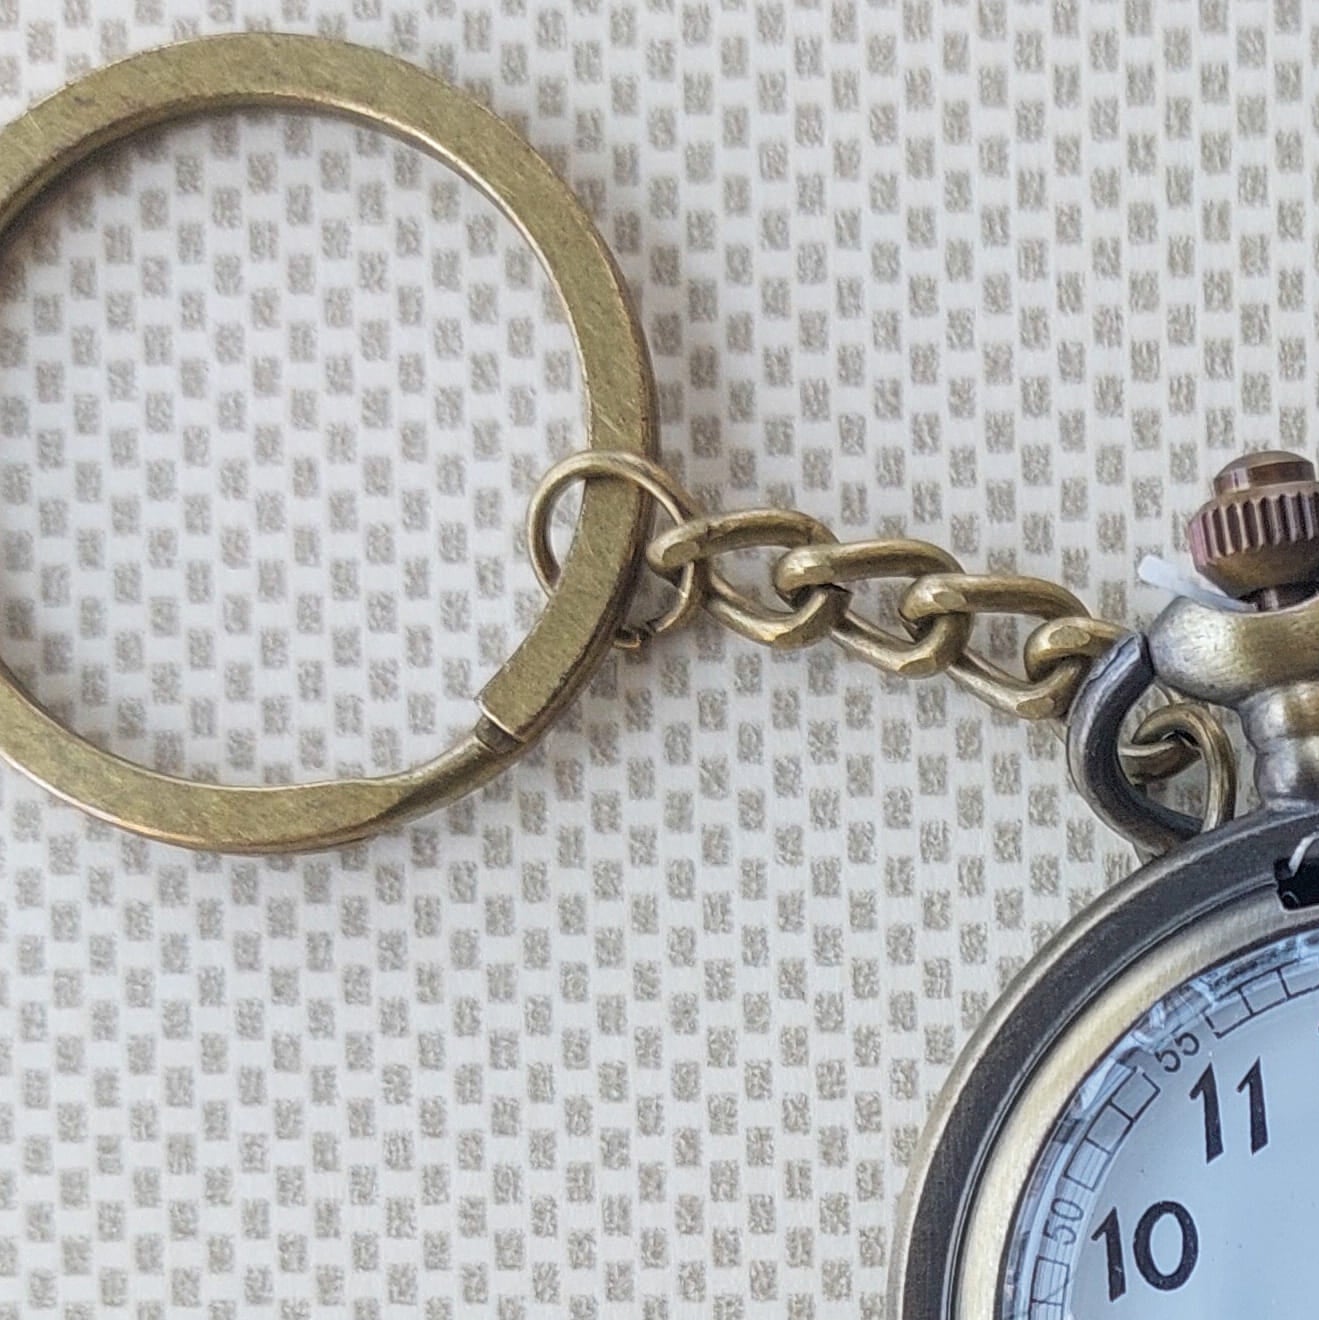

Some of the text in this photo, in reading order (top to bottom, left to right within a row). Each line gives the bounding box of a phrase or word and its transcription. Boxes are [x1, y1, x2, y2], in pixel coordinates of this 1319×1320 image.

[1154, 1031, 1199, 1073] 55
[1189, 1056, 1269, 1164] 11
[1044, 1197, 1084, 1246] 50
[1090, 1200, 1199, 1302] 10
